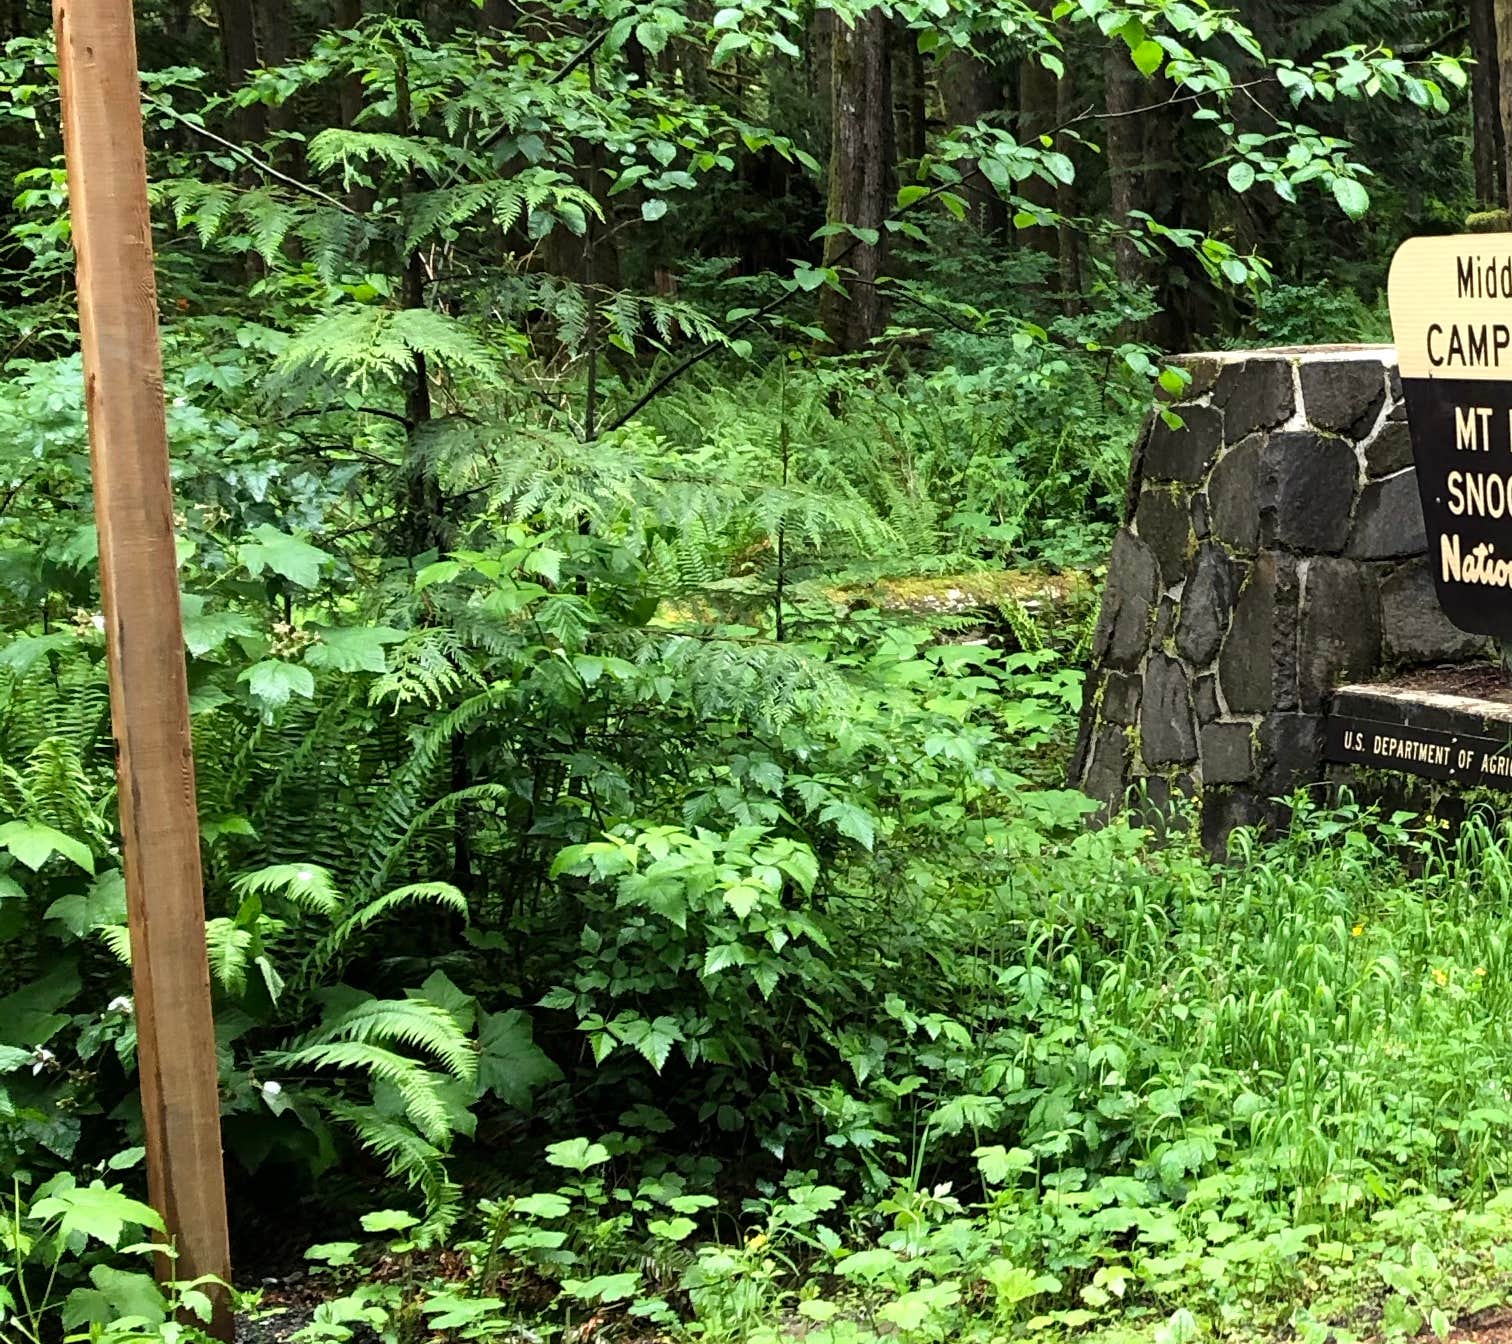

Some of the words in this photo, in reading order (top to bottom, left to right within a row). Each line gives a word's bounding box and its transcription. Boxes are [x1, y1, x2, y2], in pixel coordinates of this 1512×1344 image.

[1455, 406, 1493, 452] MT
[1343, 730, 1366, 752] U.S.
[1373, 735, 1451, 766] DEPARTMENT
[1457, 749, 1475, 770] OF
